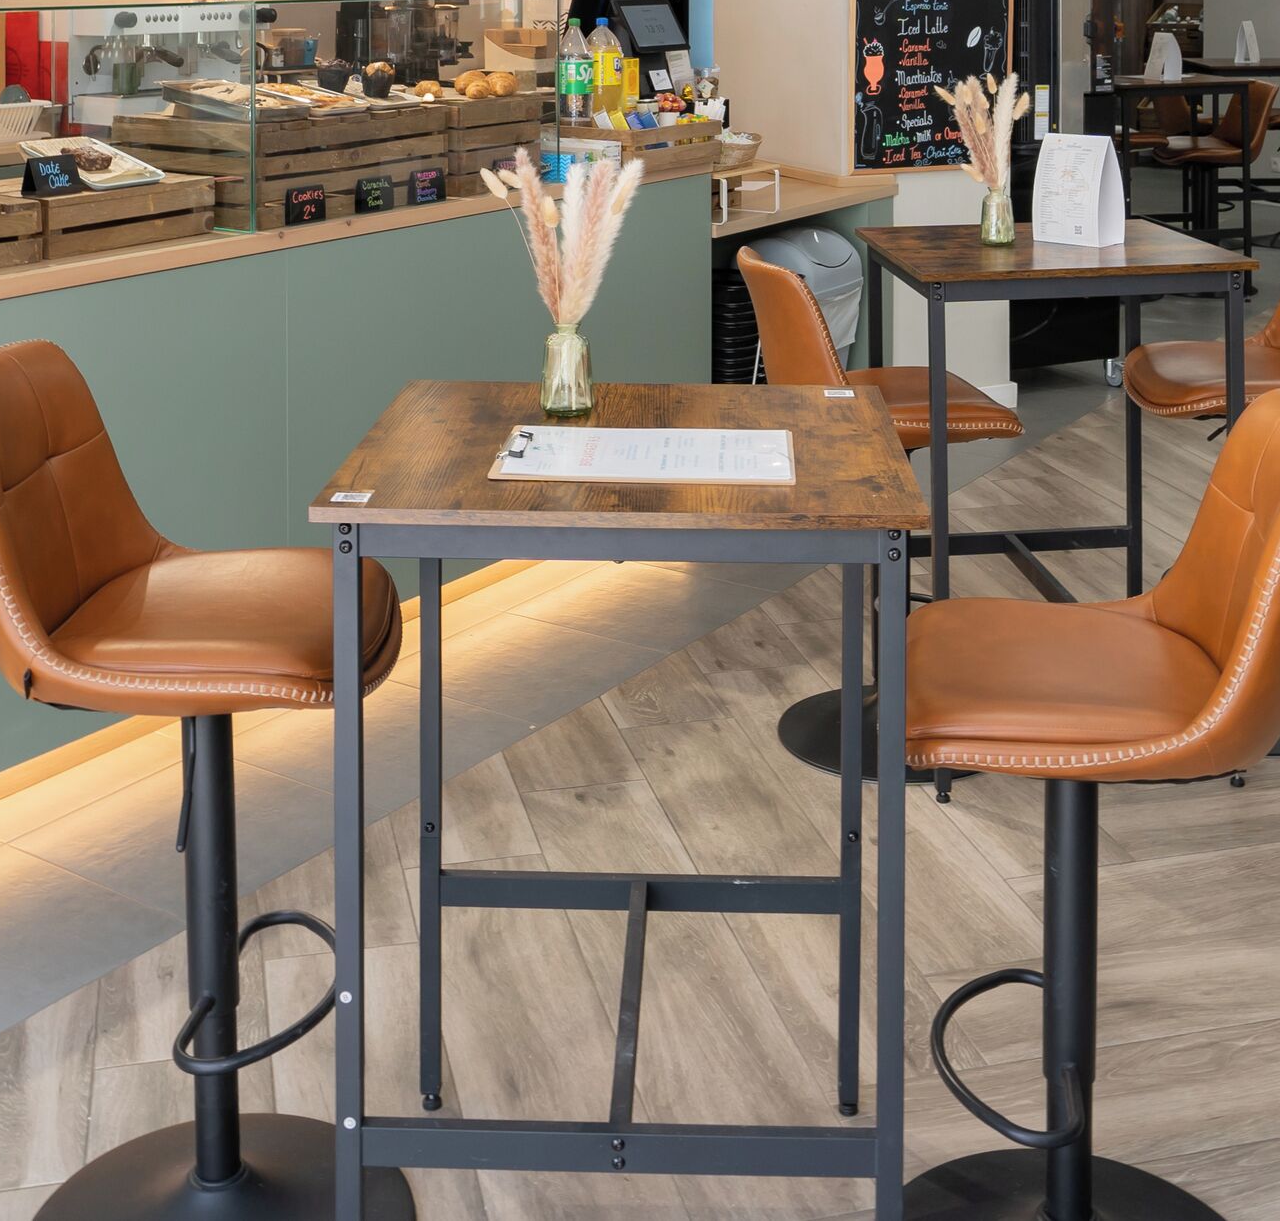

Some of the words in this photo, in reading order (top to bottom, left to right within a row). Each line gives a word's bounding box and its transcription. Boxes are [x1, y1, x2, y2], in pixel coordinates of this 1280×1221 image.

[897, 17, 921, 36] Iced
[925, 15, 949, 35] Latte
[902, 38, 931, 53] Caramel
[902, 52, 929, 66] Vanilla
[577, 63, 593, 84] Sp
[897, 66, 942, 86] Macchiatos
[901, 86, 928, 99] Caramel
[902, 99, 926, 111] Vanilla
[901, 111, 933, 131] Specials
[885, 132, 911, 147] Matcha
[935, 133, 942, 141] or
[944, 126, 963, 143] Orang
[885, 149, 906, 164] Iced
[910, 144, 922, 160] Tea
[39, 161, 61, 176] Date
[48, 174, 72, 189] Cake
